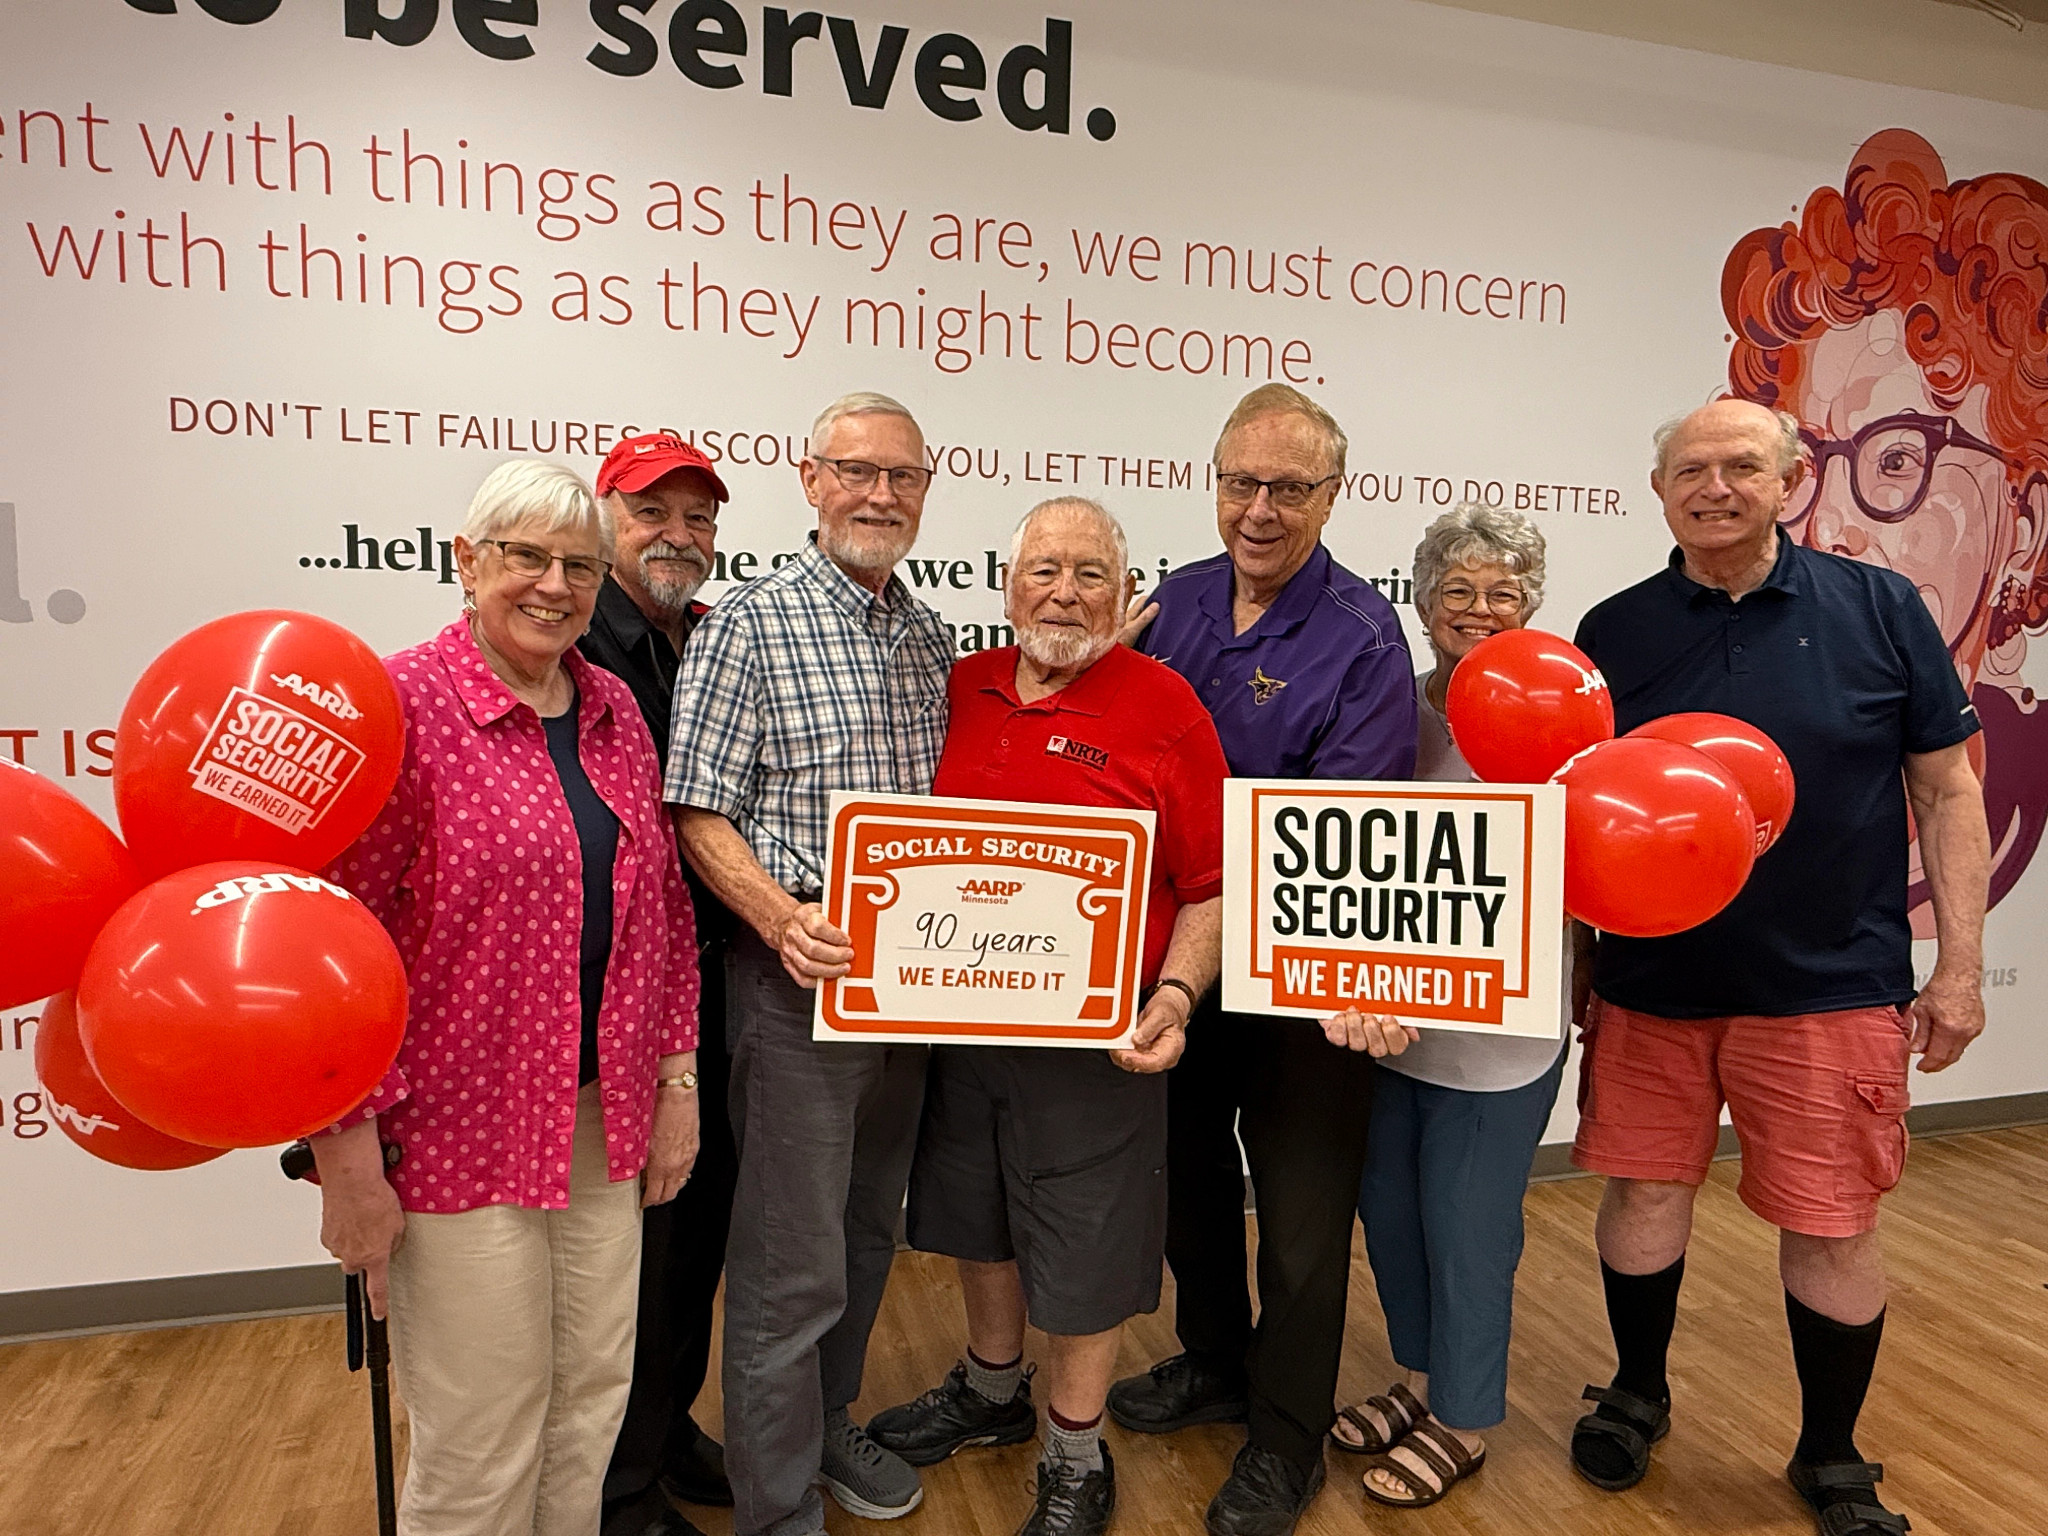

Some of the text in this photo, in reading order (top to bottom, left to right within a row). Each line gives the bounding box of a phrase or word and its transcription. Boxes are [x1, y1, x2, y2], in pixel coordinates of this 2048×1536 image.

[585, 0, 1117, 142] served.
[0, 102, 1566, 325] nt with things as they are, we must concern
[26, 209, 1325, 385] with things as they might become.
[170, 397, 322, 440] DON'T
[341, 407, 421, 445] LET
[925, 445, 1010, 487] YOU,
[1025, 451, 1087, 484] LET
[1097, 455, 1192, 491] THEM
[1343, 472, 1628, 517] YOU TO DO BETTER.
[905, 557, 974, 590] we
[270, 673, 364, 720] AARP
[63, 729, 118, 777] IS
[212, 733, 333, 806] SECURITY
[227, 700, 347, 784] SOCIAL
[1062, 738, 1110, 767] NRTA
[204, 768, 306, 827] WE EARNED IT
[866, 836, 1122, 878] SOCIAL SECURITY
[1272, 806, 1507, 887] SOCIAL
[956, 879, 1026, 897] AARP
[961, 894, 1009, 906] Minnesota
[1272, 882, 1507, 948] SECURITY
[916, 911, 1057, 969] 90 years
[898, 966, 1066, 992] WE EARNED IT
[1282, 957, 1493, 1010] WE EARNED IT
